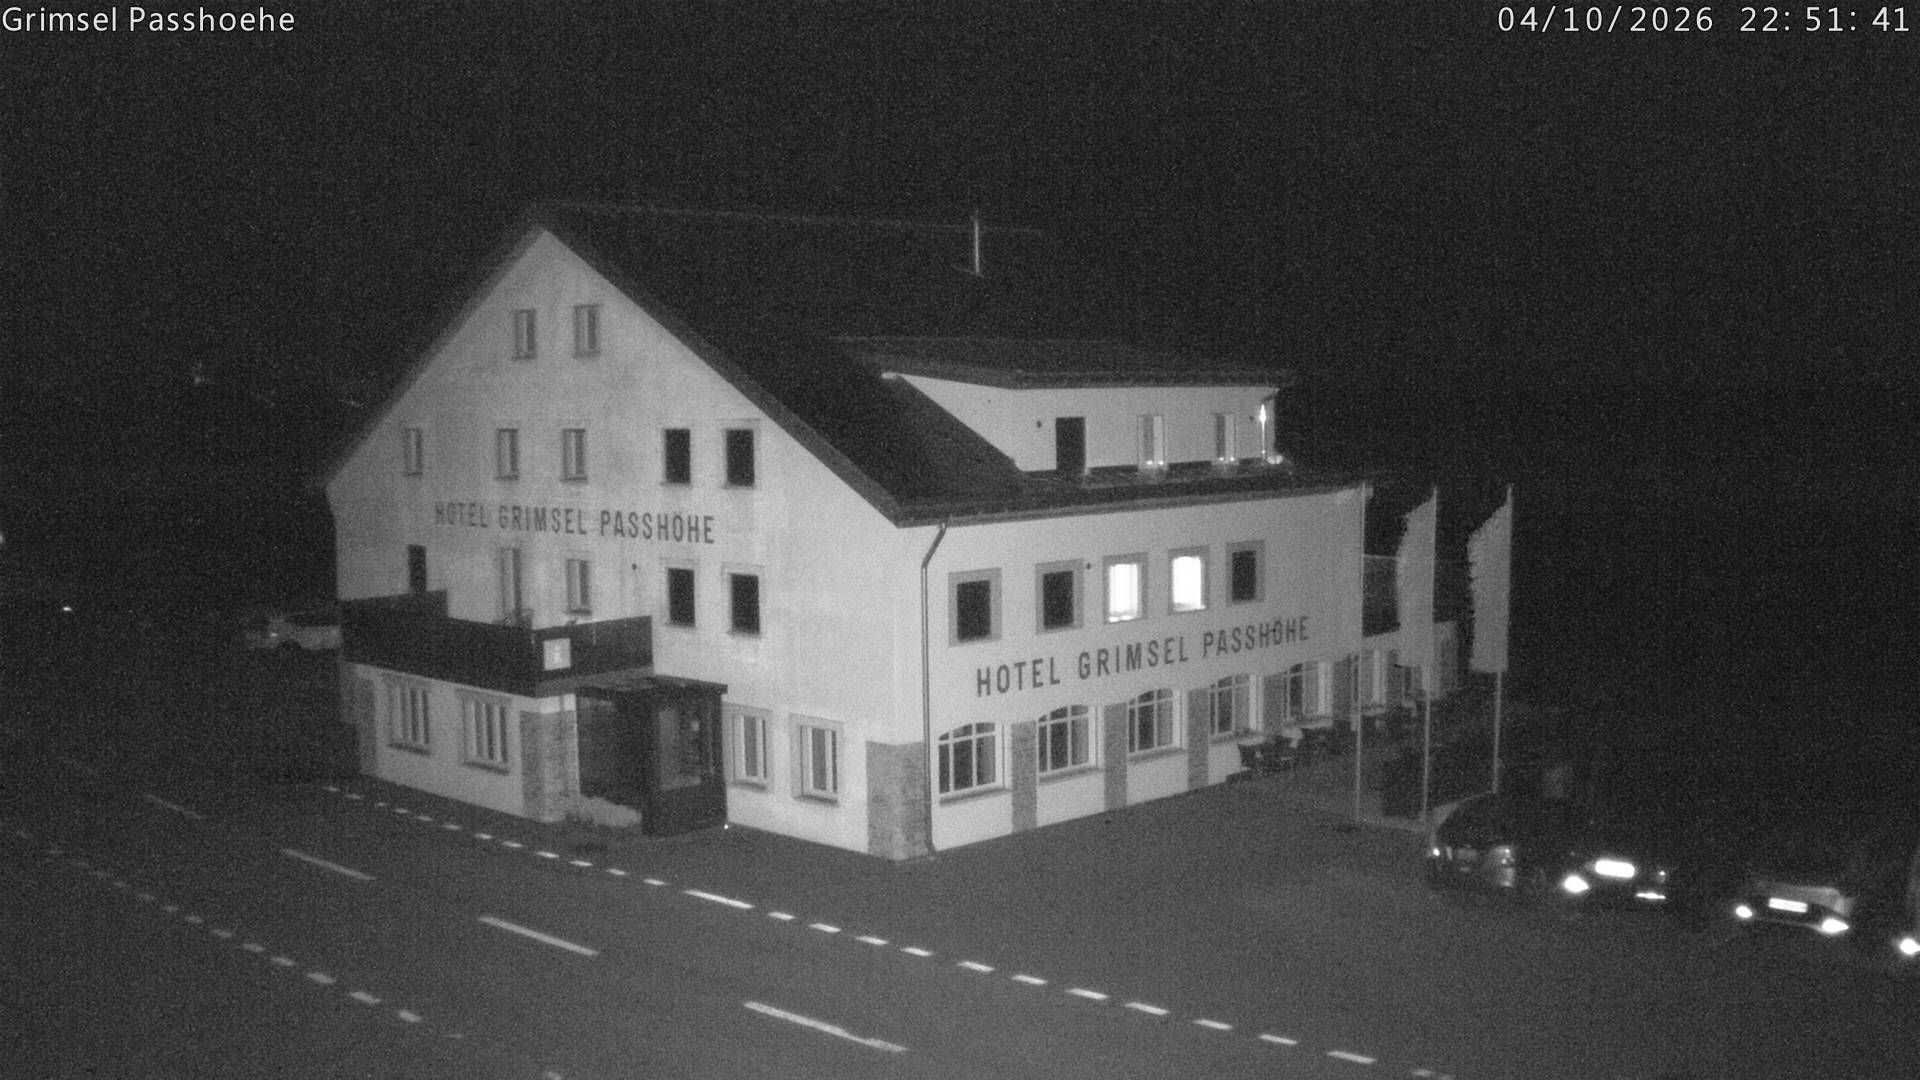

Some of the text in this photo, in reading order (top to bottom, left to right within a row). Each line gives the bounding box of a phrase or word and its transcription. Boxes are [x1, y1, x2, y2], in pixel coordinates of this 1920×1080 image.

[434, 502, 715, 544] HOTEL GRIMSEL PASSHÖHE
[976, 615, 1310, 698] HOTEL GRIMSEL PASSHÖHE
